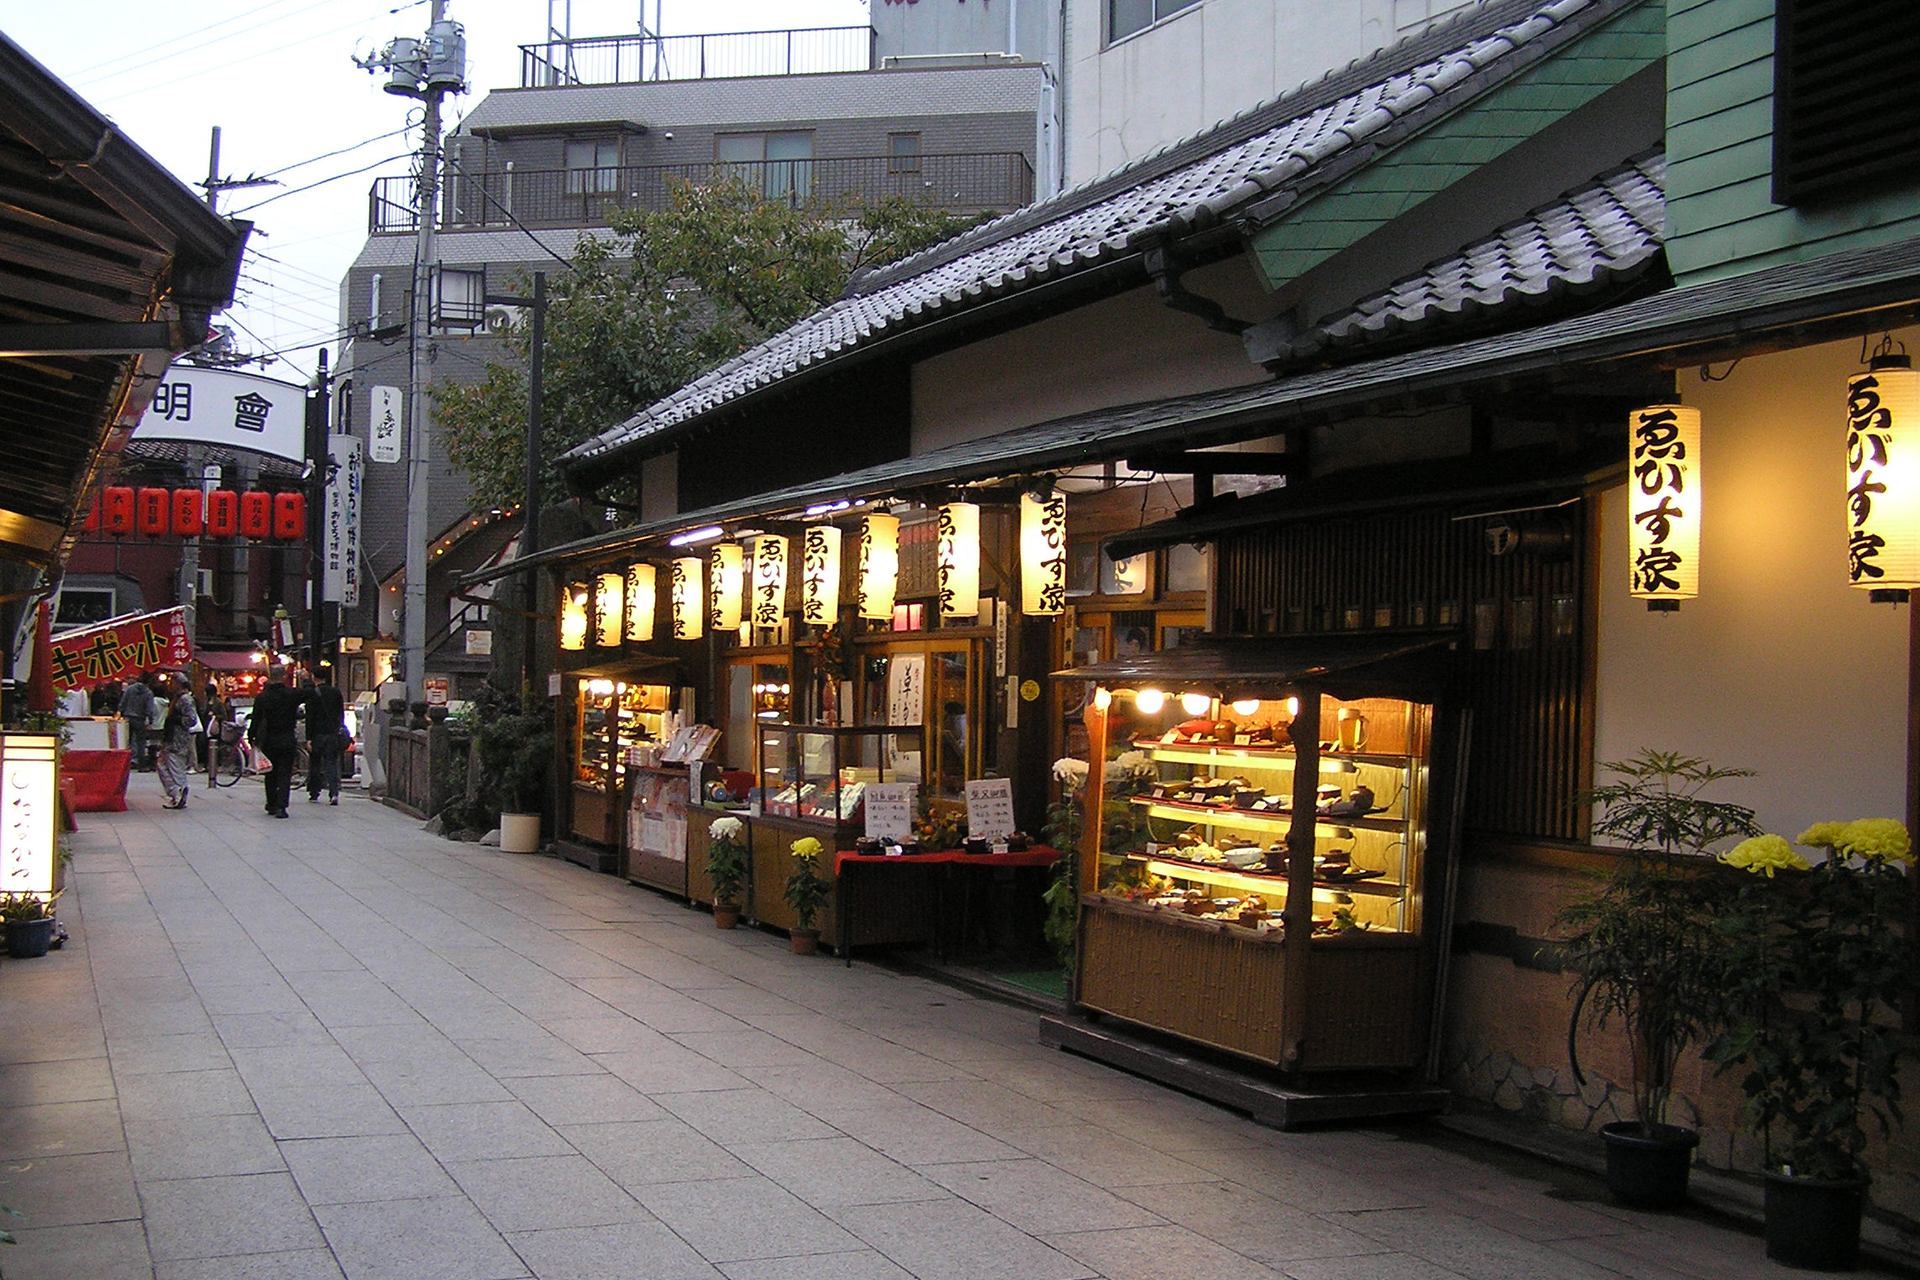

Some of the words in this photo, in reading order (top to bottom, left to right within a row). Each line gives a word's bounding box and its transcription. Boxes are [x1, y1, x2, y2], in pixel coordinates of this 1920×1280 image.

[1634, 409, 1687, 592] ゑびす家
[804, 530, 828, 620] ゑびす家
